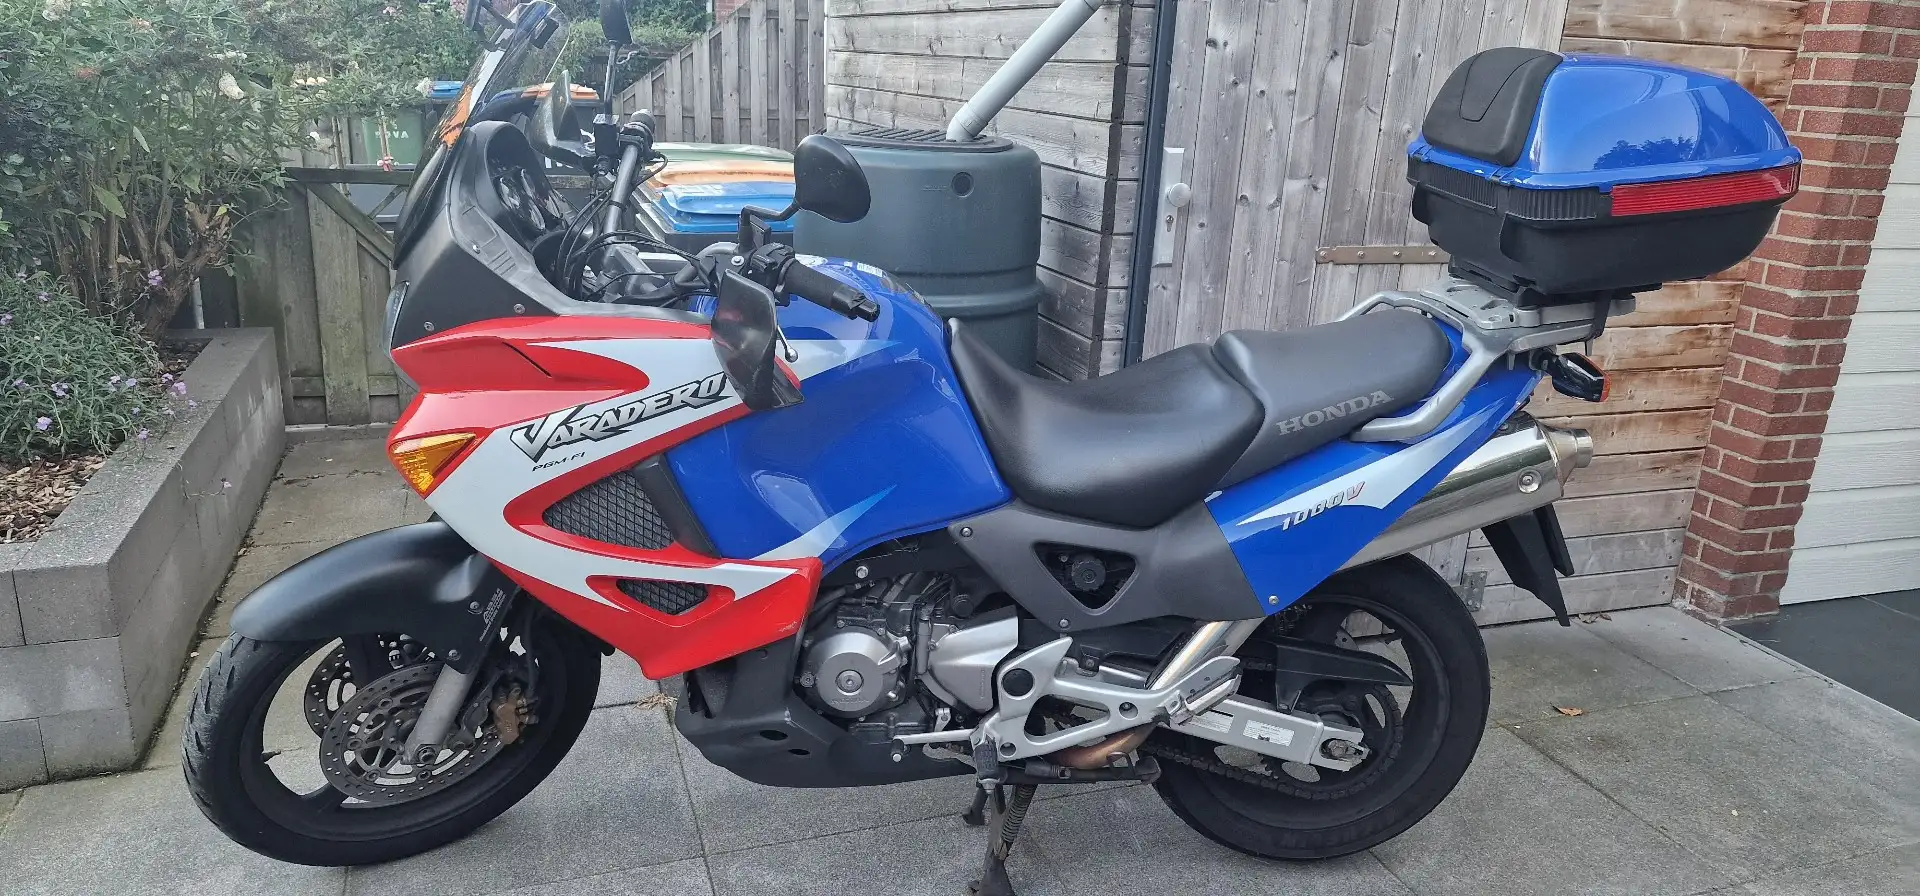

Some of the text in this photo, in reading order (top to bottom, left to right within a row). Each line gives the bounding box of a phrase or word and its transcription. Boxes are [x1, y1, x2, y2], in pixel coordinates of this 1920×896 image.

[509, 371, 734, 463] VARADERO
[1276, 390, 1394, 436] HONDA
[532, 451, 586, 472] PGM-FI
